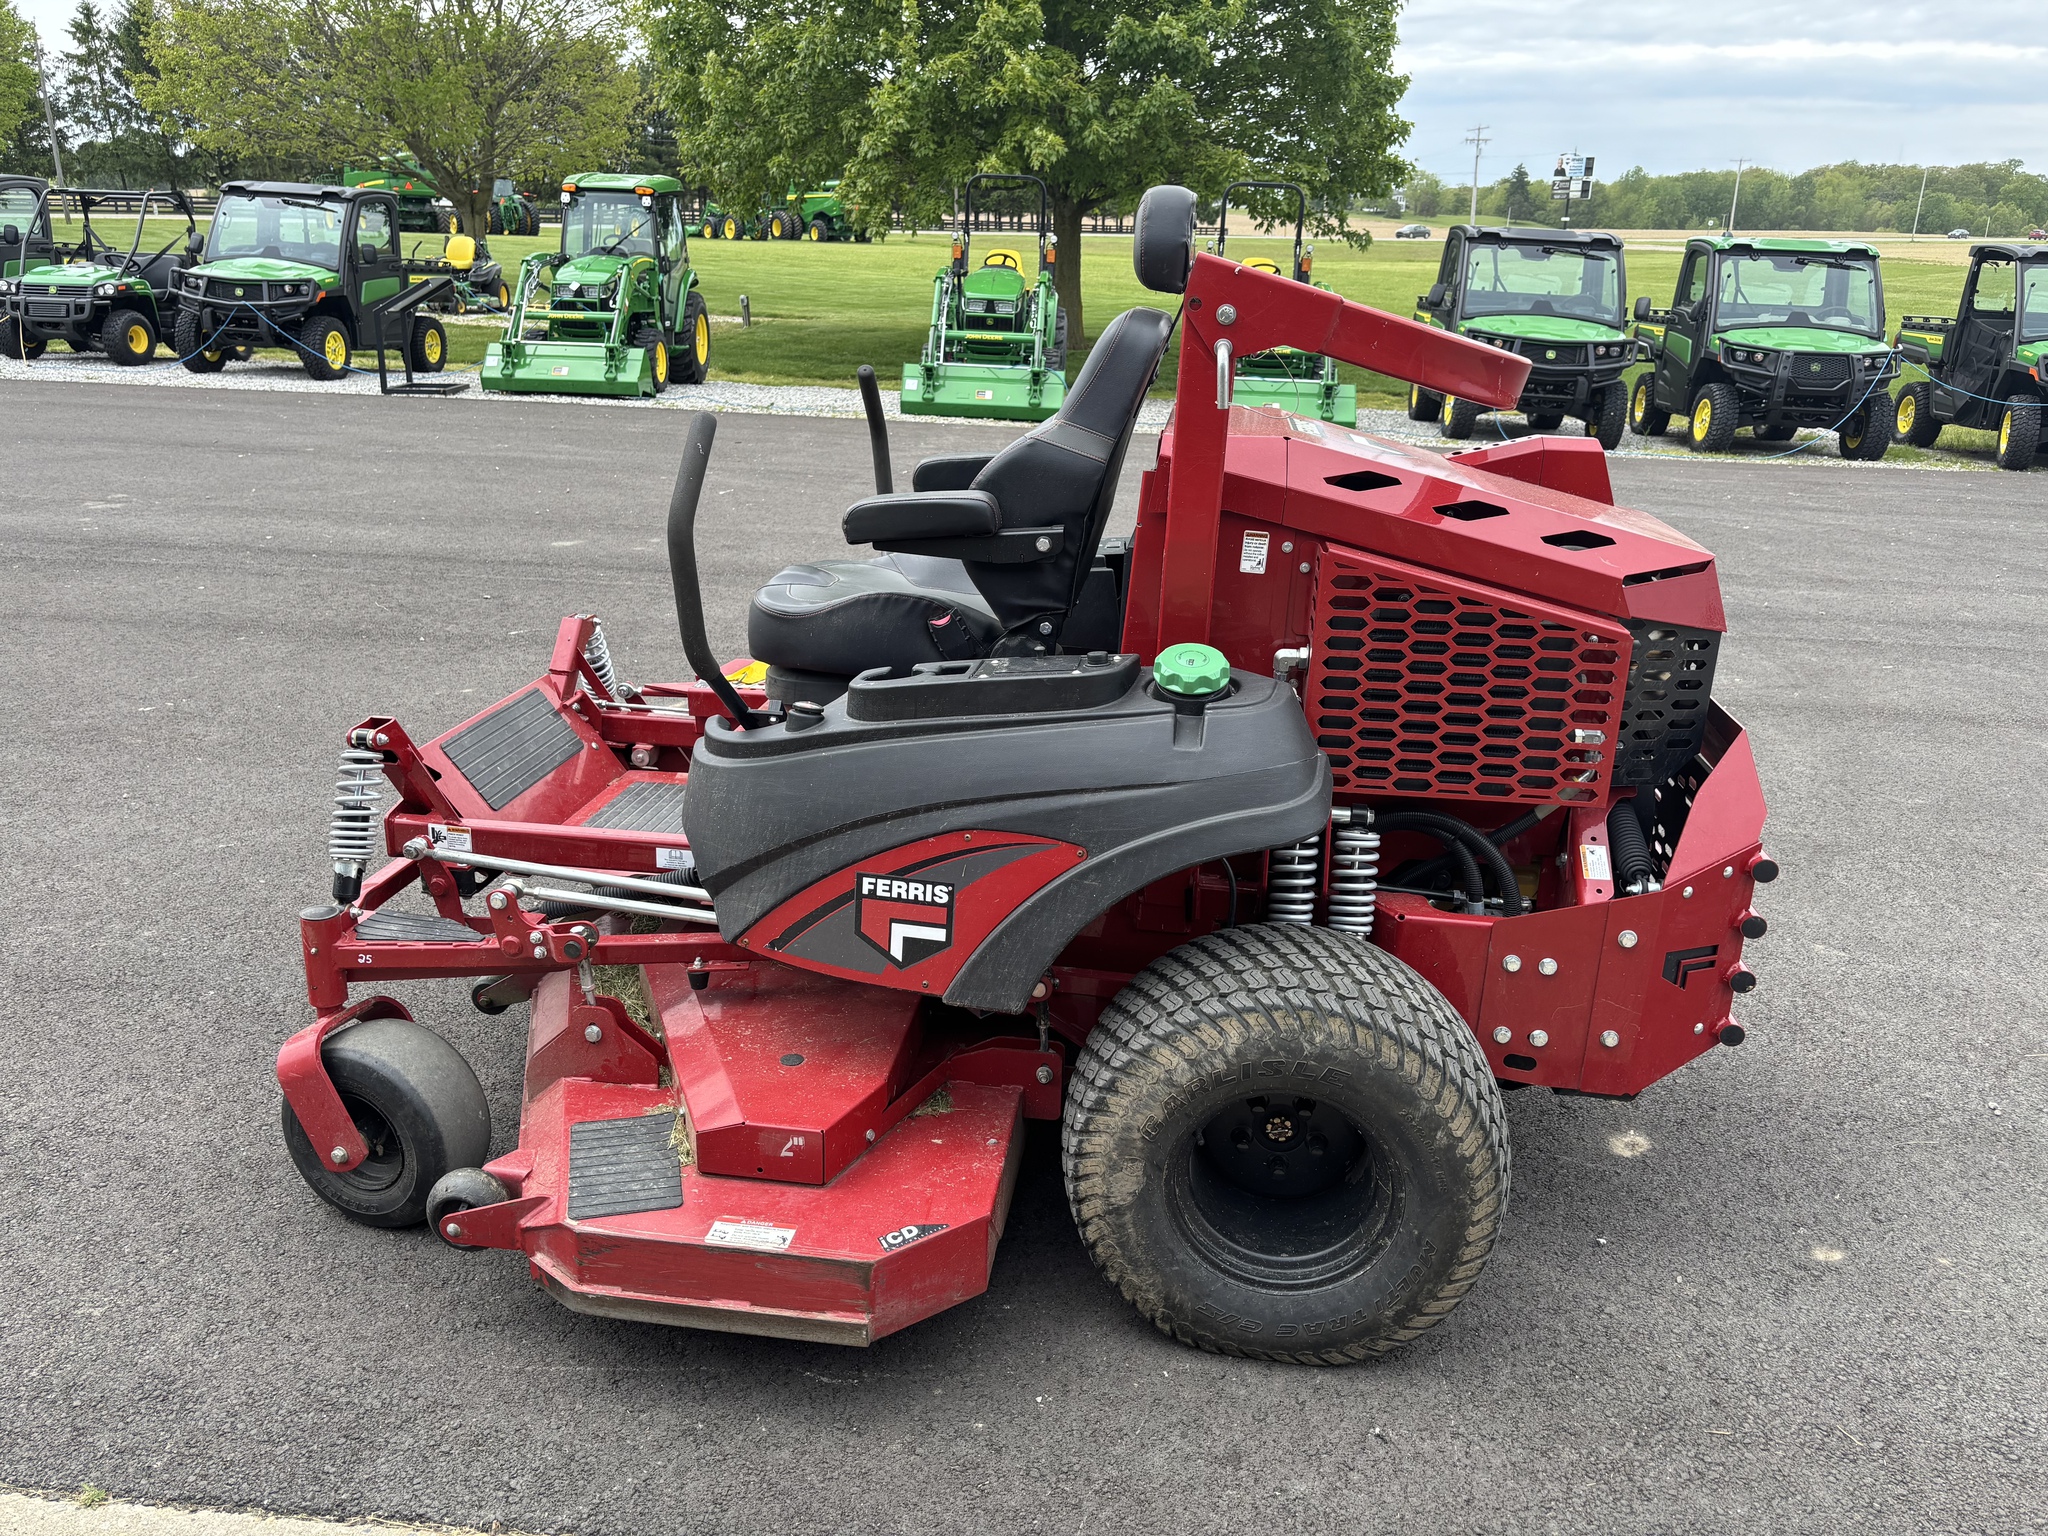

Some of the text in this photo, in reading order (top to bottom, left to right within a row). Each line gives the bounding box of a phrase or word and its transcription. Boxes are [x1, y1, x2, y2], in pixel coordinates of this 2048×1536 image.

[862, 877, 949, 904] FERRIS
[1138, 1058, 1352, 1142] CARLISLE
[1373, 1238, 1438, 1314] MULTI
[1275, 1307, 1368, 1338] TRAC
